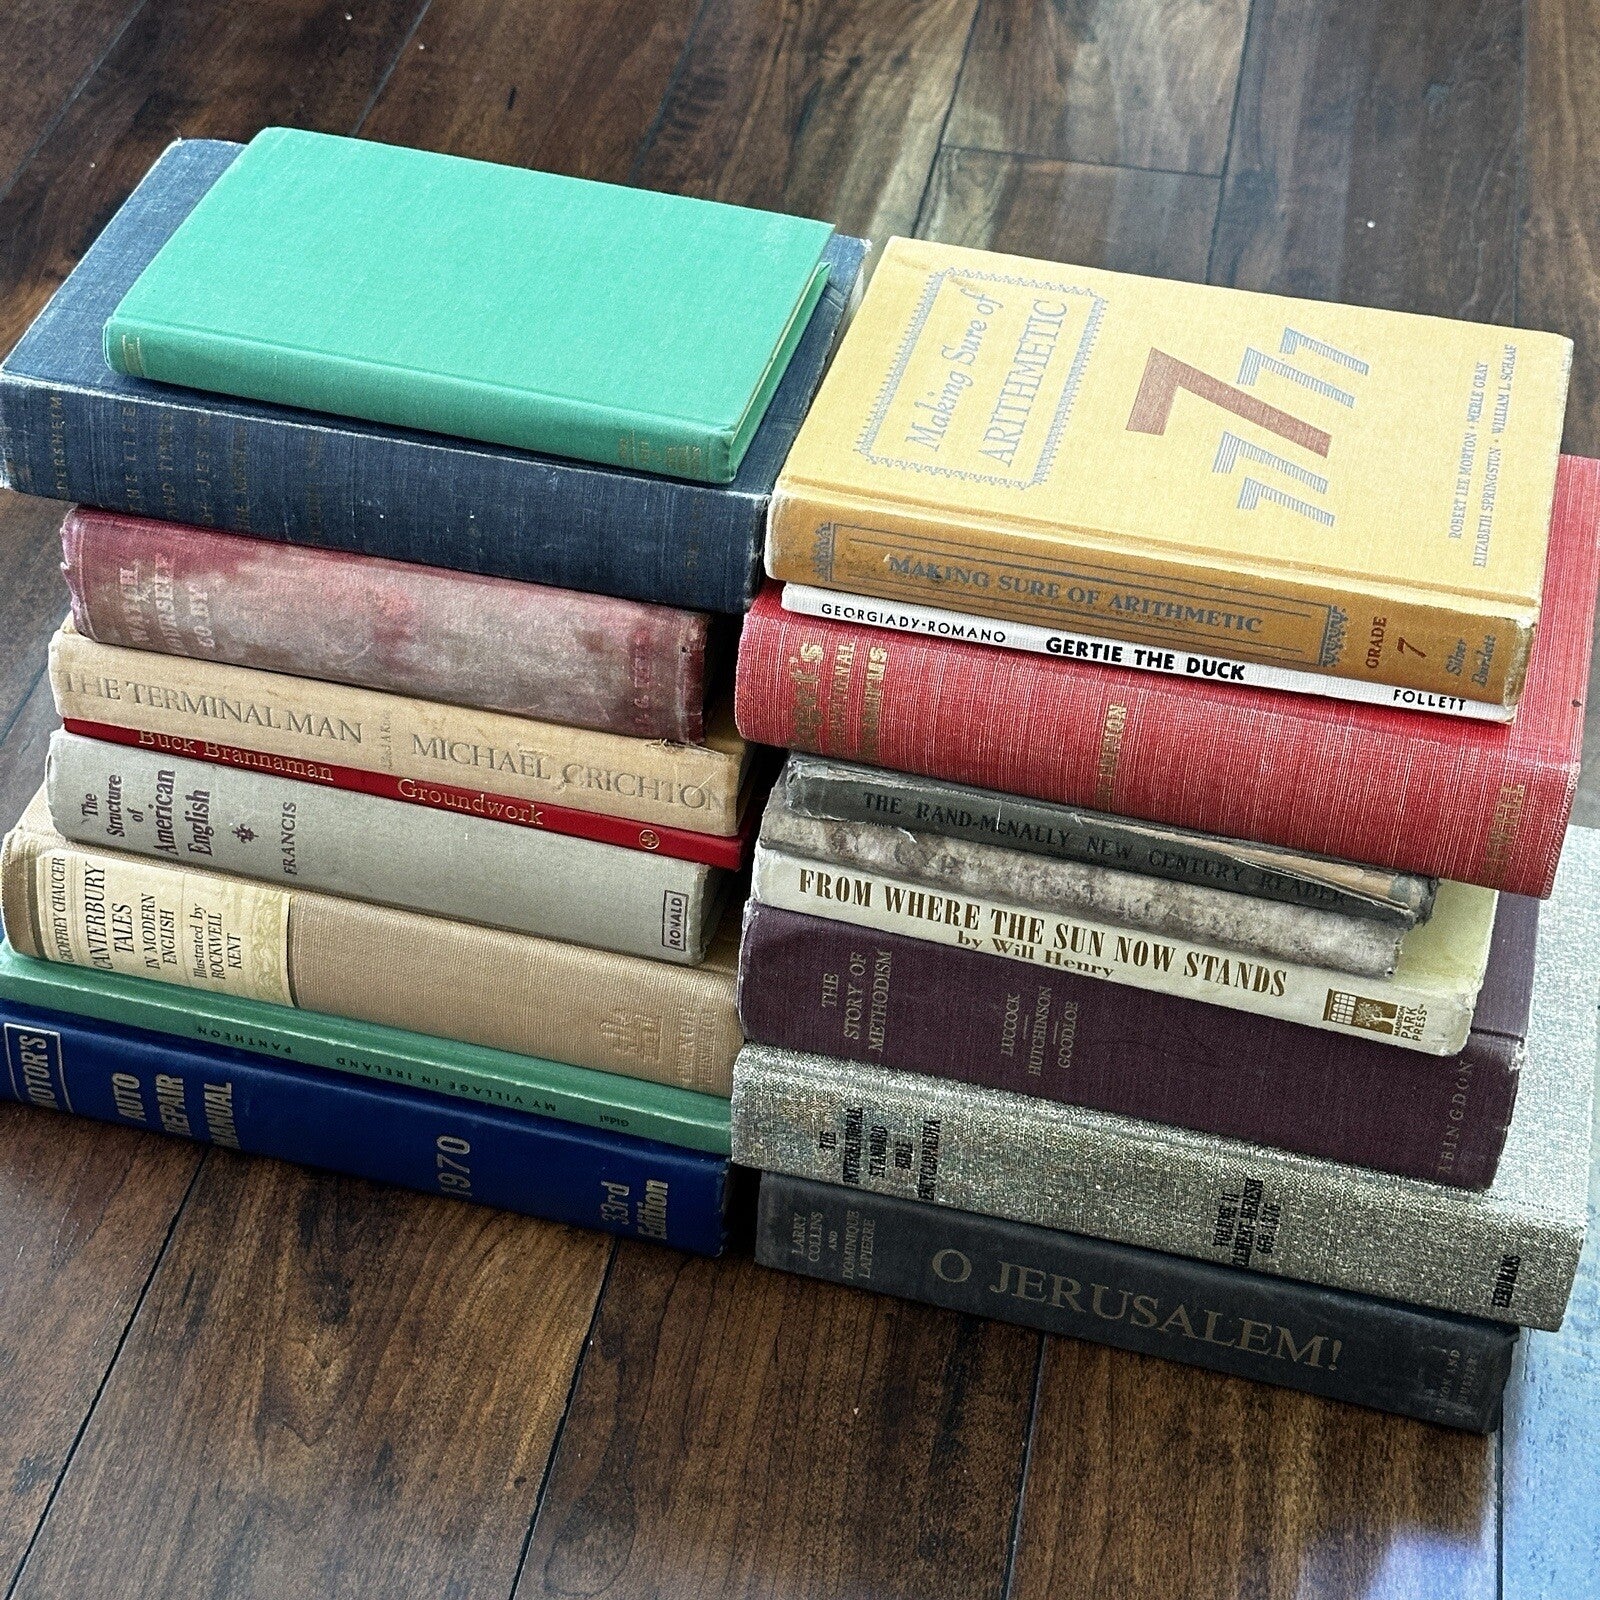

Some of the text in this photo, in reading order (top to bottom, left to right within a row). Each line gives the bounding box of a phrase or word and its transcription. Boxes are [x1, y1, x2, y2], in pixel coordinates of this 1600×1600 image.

[905, 287, 1004, 452] Making Sure of
[978, 299, 1068, 467] ARITHMETIC
[1500, 344, 1517, 381] SCHAAF
[1125, 346, 1332, 458] 7
[1491, 393, 1510, 434] WILLIAM
[1448, 361, 1488, 539] ROBERT LEE MORTON MERLE GRAY
[1480, 446, 1502, 512] SPRINGSTUN
[1473, 514, 1492, 568] ELIZABETH
[885, 554, 1264, 634] MAKING SURE OF ARITHMETIC
[1046, 636, 1246, 681] GERTIE THE DUCK
[1365, 615, 1388, 670] GRADE
[1396, 636, 1429, 660] 7
[59, 669, 121, 701] THE
[125, 680, 282, 729] TERMINAL
[285, 709, 364, 745] MAN
[1393, 688, 1467, 712] FOLLETT
[138, 730, 335, 782] Buck Brannaman
[411, 732, 551, 781] MICHAEL
[561, 762, 727, 811] CRICHTON
[82, 792, 99, 819] The
[106, 773, 125, 837] Structure
[132, 807, 144, 823] of
[148, 769, 179, 856] American
[186, 789, 214, 857] English
[396, 778, 544, 825] Groundwork
[281, 801, 298, 877] FRANCIS
[863, 791, 903, 817] THE
[1085, 835, 1135, 860] NEW
[1148, 849, 1245, 884] CENTURY
[51, 857, 67, 907] CHAUCER
[83, 861, 114, 971] CANTERBURY
[112, 903, 136, 955] TALES
[140, 892, 161, 971] IN MODERN
[160, 908, 178, 966] ENGLISH
[189, 902, 208, 979] Illustrated by
[208, 912, 226, 980] ROCKWELL
[668, 896, 683, 948] RONALD
[798, 868, 1288, 998] FROM WHERE THE SUN NOW STANDS
[227, 932, 243, 970] KENT
[956, 930, 1115, 979] by Will Henry
[822, 972, 840, 1009] THE
[843, 951, 867, 1041] STORY OF
[867, 950, 893, 1053] METHODISM
[1394, 1004, 1408, 1037] MADISON
[196, 1025, 293, 1055] PANTHEON
[1002, 992, 1022, 1057] LUCCOCK
[1027, 985, 1053, 1078] HUTCHINSON
[1057, 1000, 1079, 1069] GOODLOE
[1400, 1005, 1419, 1040] PARK
[111, 1071, 147, 1123] AUTO
[155, 1073, 193, 1138] REPAIR
[335, 1056, 558, 1113] MY VILLAGE IN IRELAND
[203, 1082, 243, 1151] MANUAL
[599, 1114, 631, 1128] Gidal
[842, 1107, 864, 1185] INTERNATIONAL
[1438, 1058, 1475, 1175] ABINGDON
[436, 1134, 473, 1199] 1970
[869, 1126, 889, 1179] STANDARD
[601, 1180, 631, 1227] 33rd
[636, 1179, 670, 1242] Edition
[791, 1213, 807, 1256] LARRY
[808, 1211, 824, 1263] COLLINS
[828, 1229, 839, 1251] AND
[841, 1209, 861, 1280] DOMINIQUE
[858, 1217, 876, 1279] LAPIERRE
[931, 1248, 1345, 1371] O JERUSALEM!
